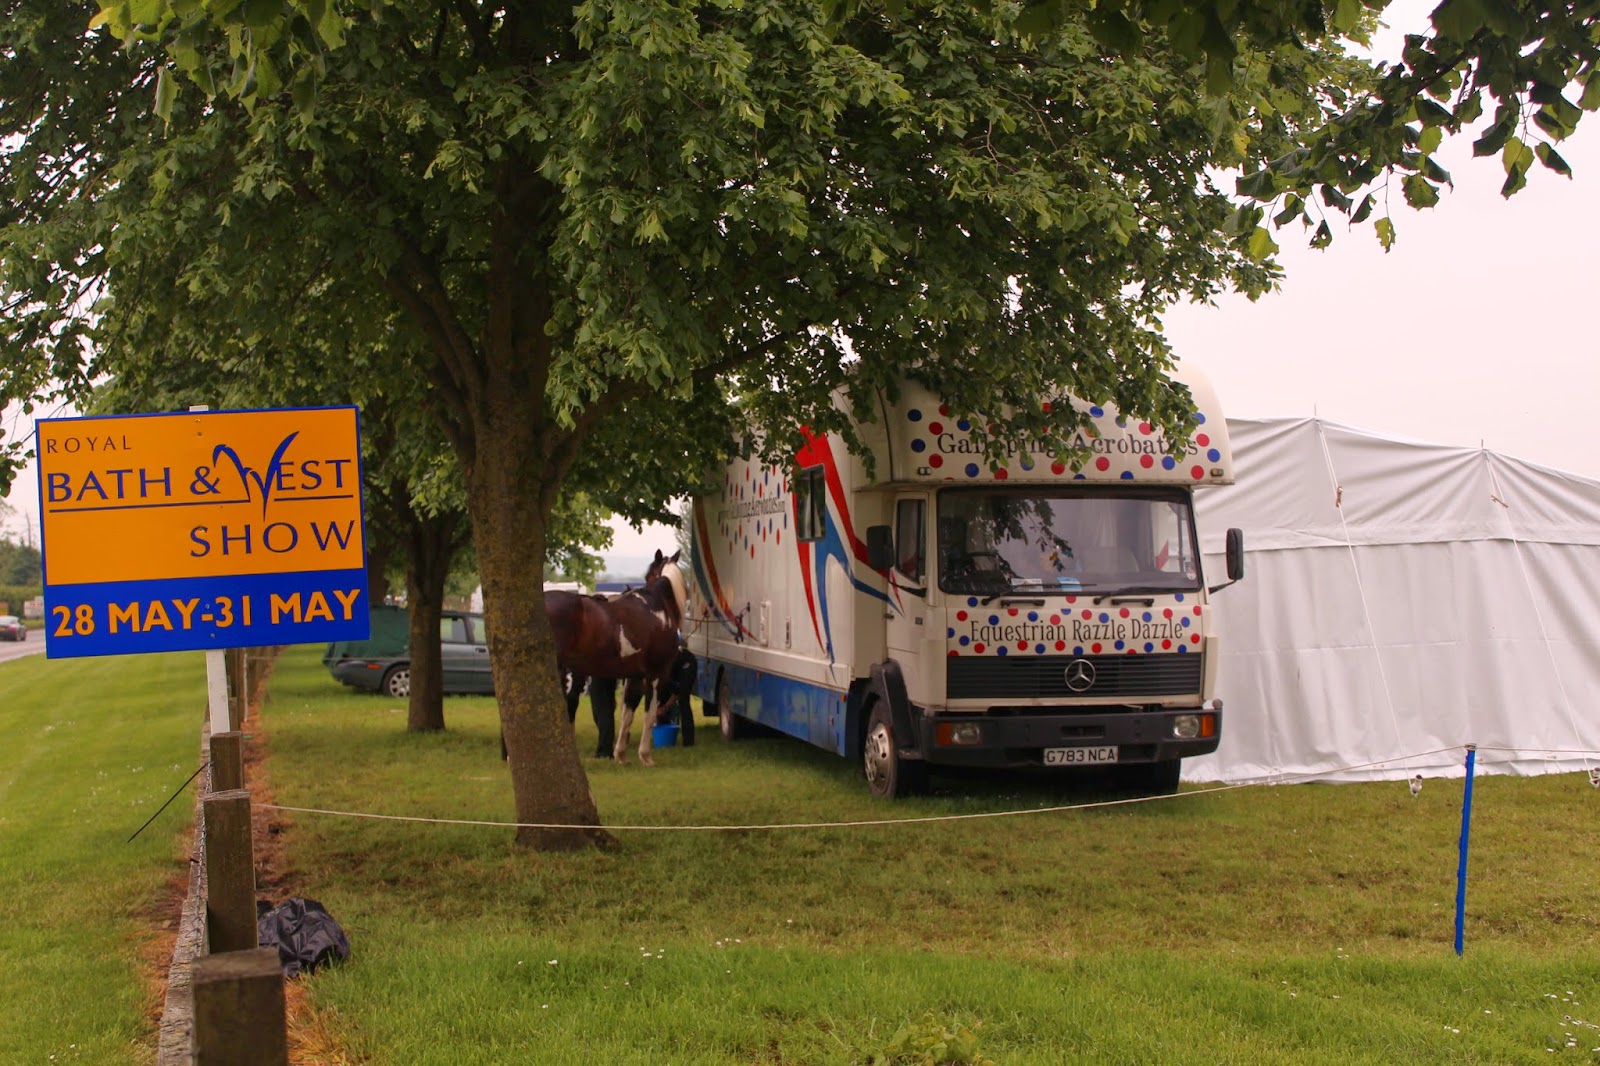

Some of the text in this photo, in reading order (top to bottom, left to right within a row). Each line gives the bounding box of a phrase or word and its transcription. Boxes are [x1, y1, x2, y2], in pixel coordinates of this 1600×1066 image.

[46, 435, 132, 454] ROYAL
[937, 432, 1198, 459] Gallping Acrobats
[47, 430, 352, 522] BATH & WEST
[189, 520, 355, 558] SHOW
[52, 604, 95, 637] 28
[269, 588, 361, 625] MAY
[970, 617, 1183, 646] Equestrian Razzle Dazzle
[1046, 747, 1116, 764] G783 NCA
